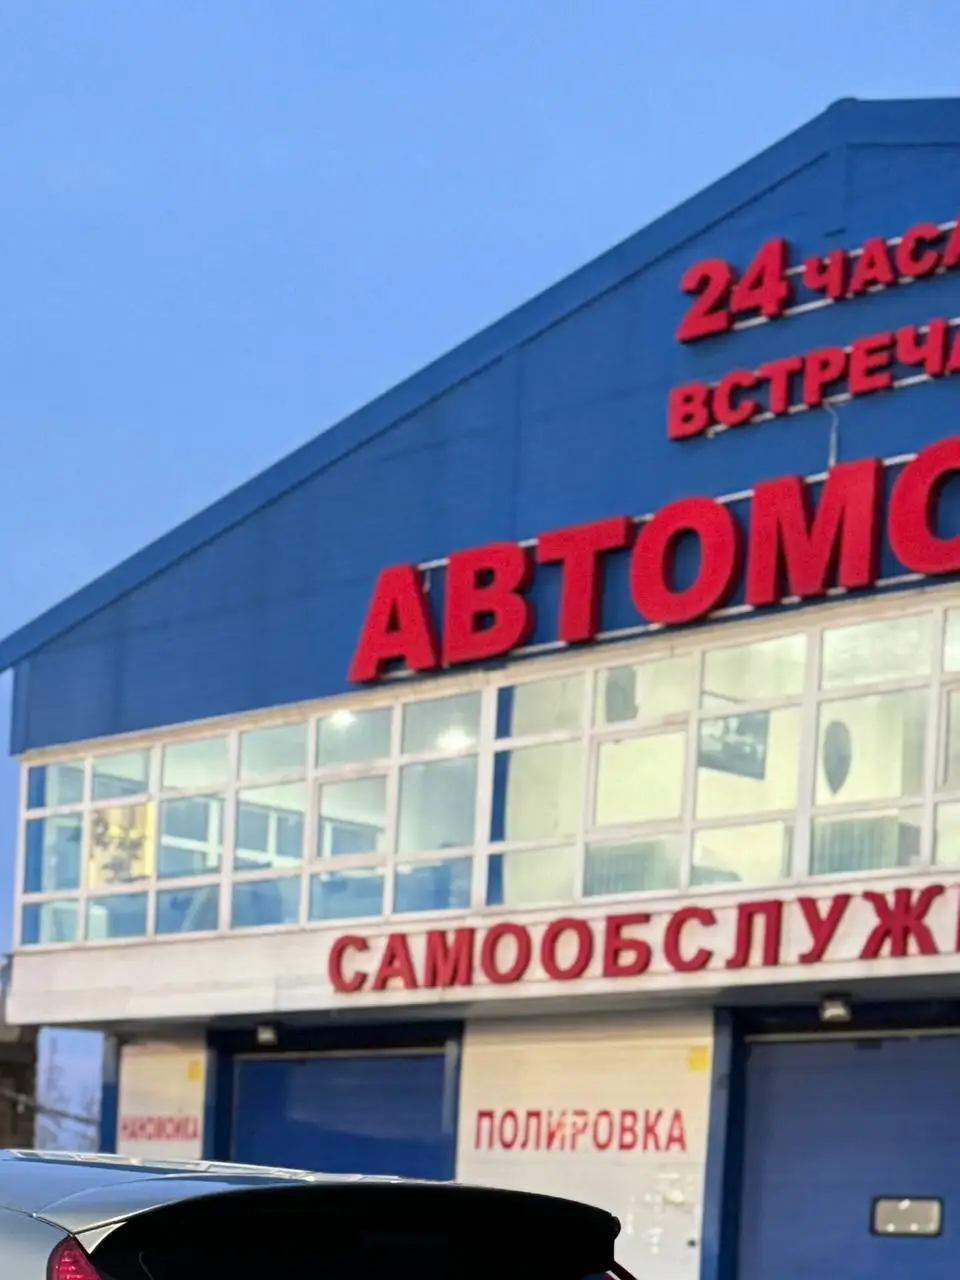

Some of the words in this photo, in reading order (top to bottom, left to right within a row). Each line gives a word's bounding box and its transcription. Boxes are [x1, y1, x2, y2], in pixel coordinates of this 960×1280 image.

[675, 236, 789, 342] 24
[667, 317, 960, 440] ВСТРЕЧ
[328, 884, 960, 993] САМООБСЛУЖ
[475, 1108, 687, 1151] ПОЛИРОВКА
